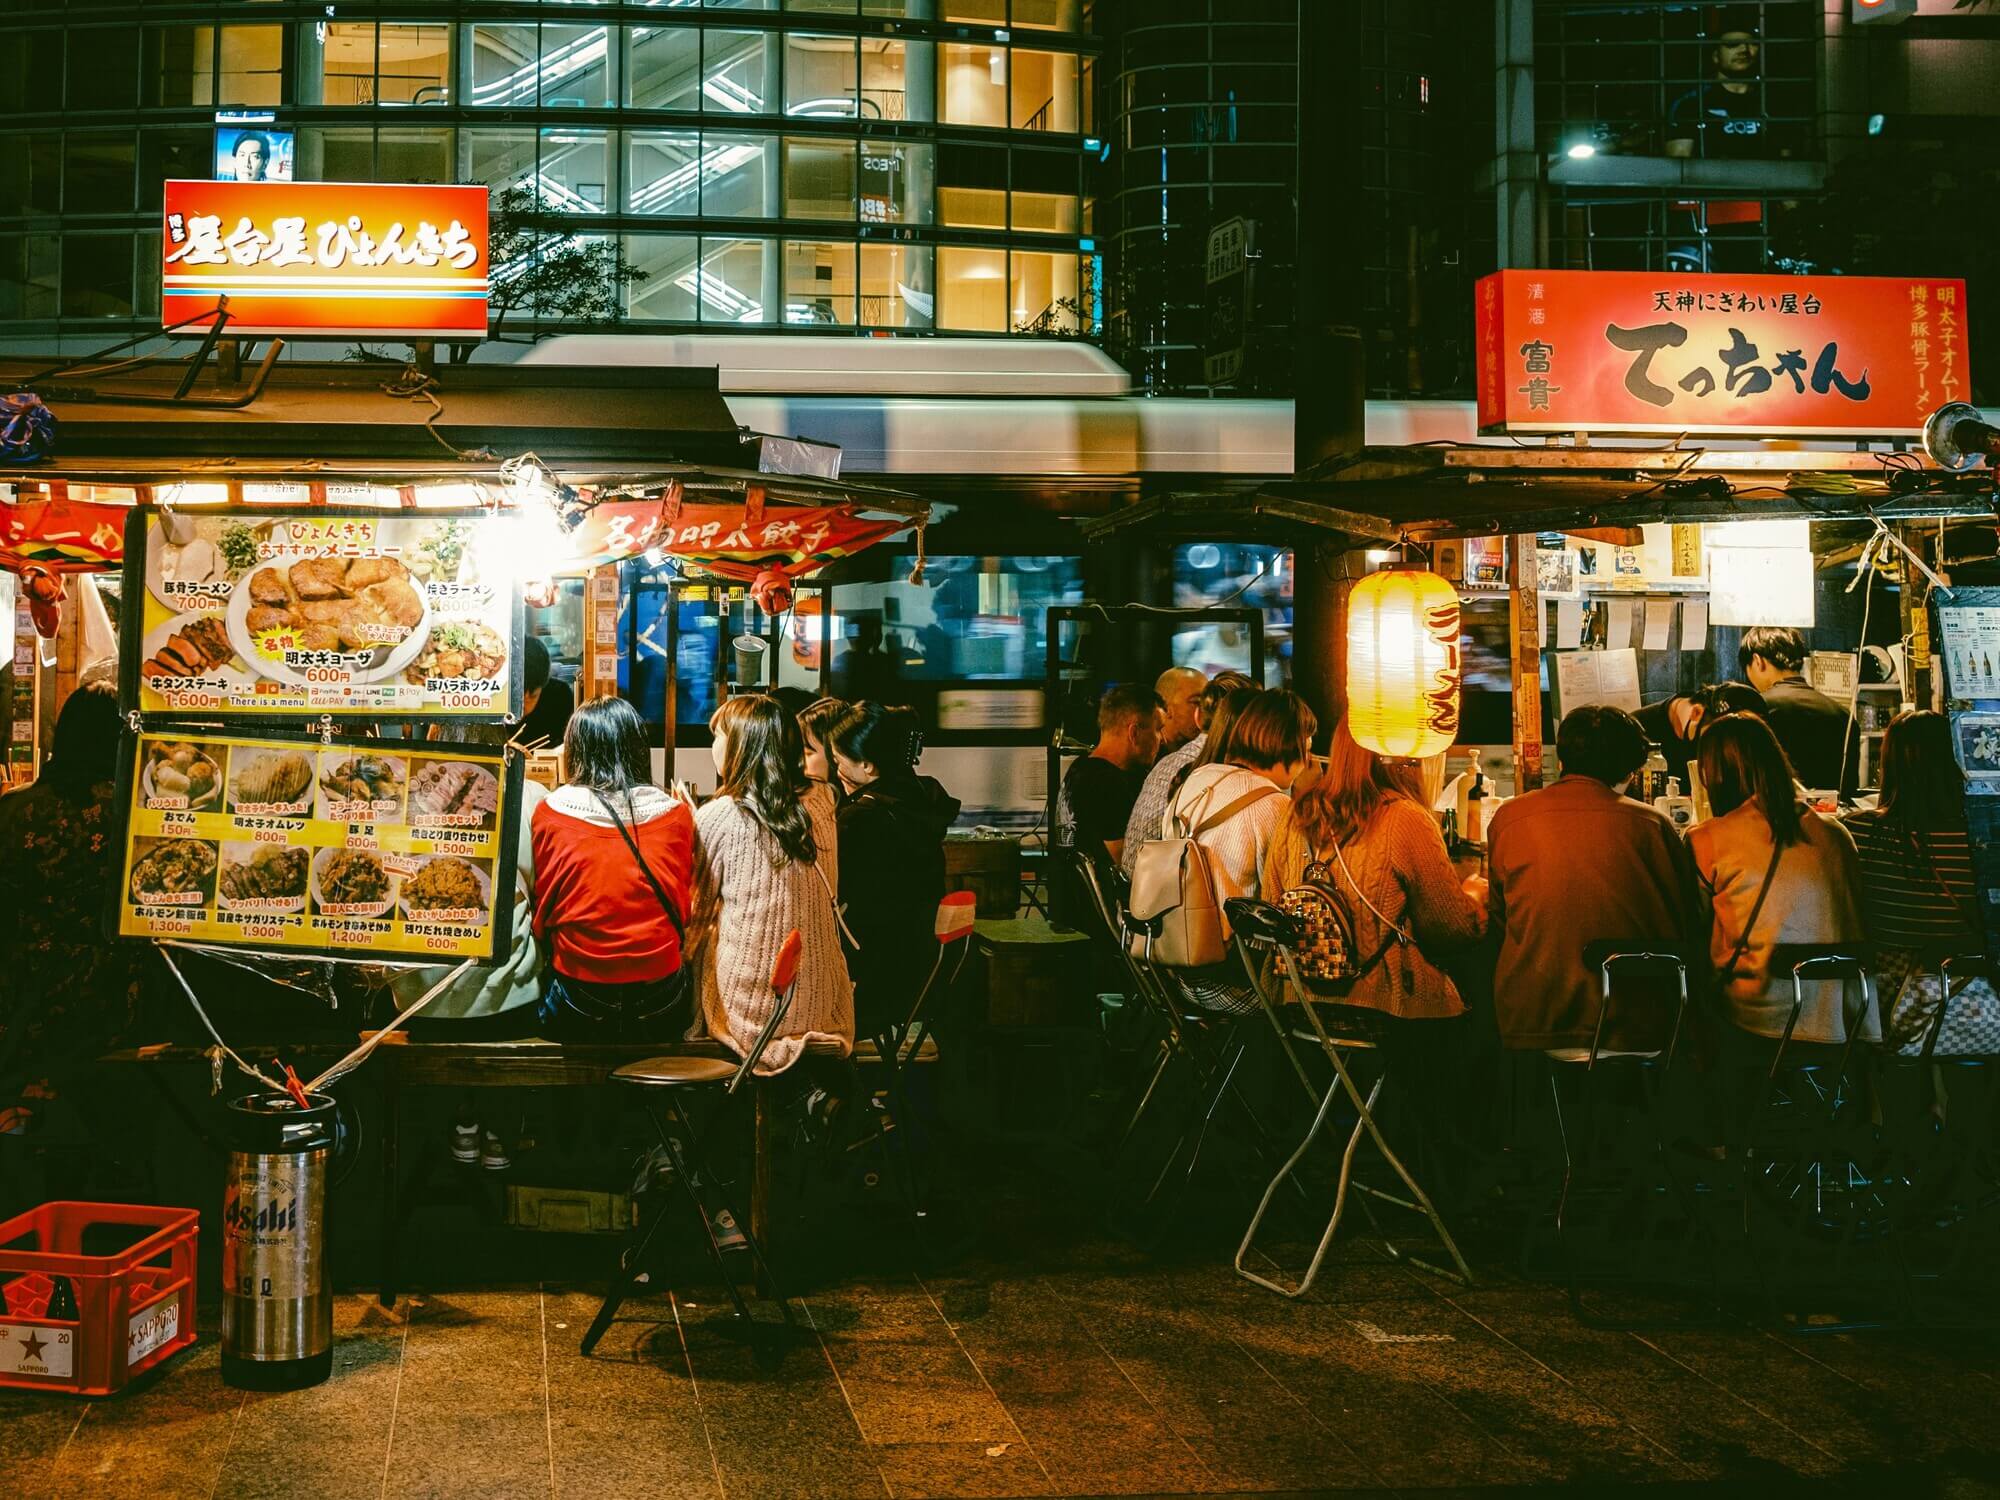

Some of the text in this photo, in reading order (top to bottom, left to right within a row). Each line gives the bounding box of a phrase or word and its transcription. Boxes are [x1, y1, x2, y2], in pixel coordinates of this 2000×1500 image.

[1527, 283, 1545, 325] 清酒
[1652, 290, 1822, 316] 天神にぎわい屋台
[1936, 286, 1960, 402] 明太子オムレ
[1909, 285, 1932, 422] 博多豚骨ラーメン
[1605, 321, 1871, 408] てっちゃん
[1519, 337, 1560, 412] 富貴
[290, 522, 373, 541] ぴょんきち
[258, 541, 403, 560] おすすめメニュー
[164, 581, 233, 595] 豚骨ラーメン
[177, 596, 218, 610] 700円
[263, 635, 295, 652] 名物
[285, 650, 373, 667] 明太ギョーザ
[306, 668, 351, 683] 600円
[151, 678, 229, 691] 牛タンステーキ
[164, 692, 221, 708] 1,600円
[230, 696, 305, 707] There is a menu
[329, 697, 345, 706] PAY
[440, 694, 491, 709] 1,000円
[164, 812, 196, 824] おでん
[233, 816, 306, 831] 明太子オムレツ
[254, 831, 288, 845] 800円
[346, 837, 378, 849] 600円
[433, 843, 475, 856] 1,500円
[216, 912, 305, 927] 国産牛サガリステーキ
[407, 908, 480, 921] うまいがしみわたる!
[149, 920, 192, 934] 1,300円
[242, 926, 285, 939] 1,900円
[404, 923, 482, 939] 残りだれ焼きめし
[330, 931, 373, 945] 1,200円
[426, 938, 459, 951] 600円
[226, 1197, 297, 1233] Asahi
[137, 1304, 179, 1345] SAPPORO
[58, 1333, 70, 1345] 20
[17, 1363, 50, 1375] SAPPORO
